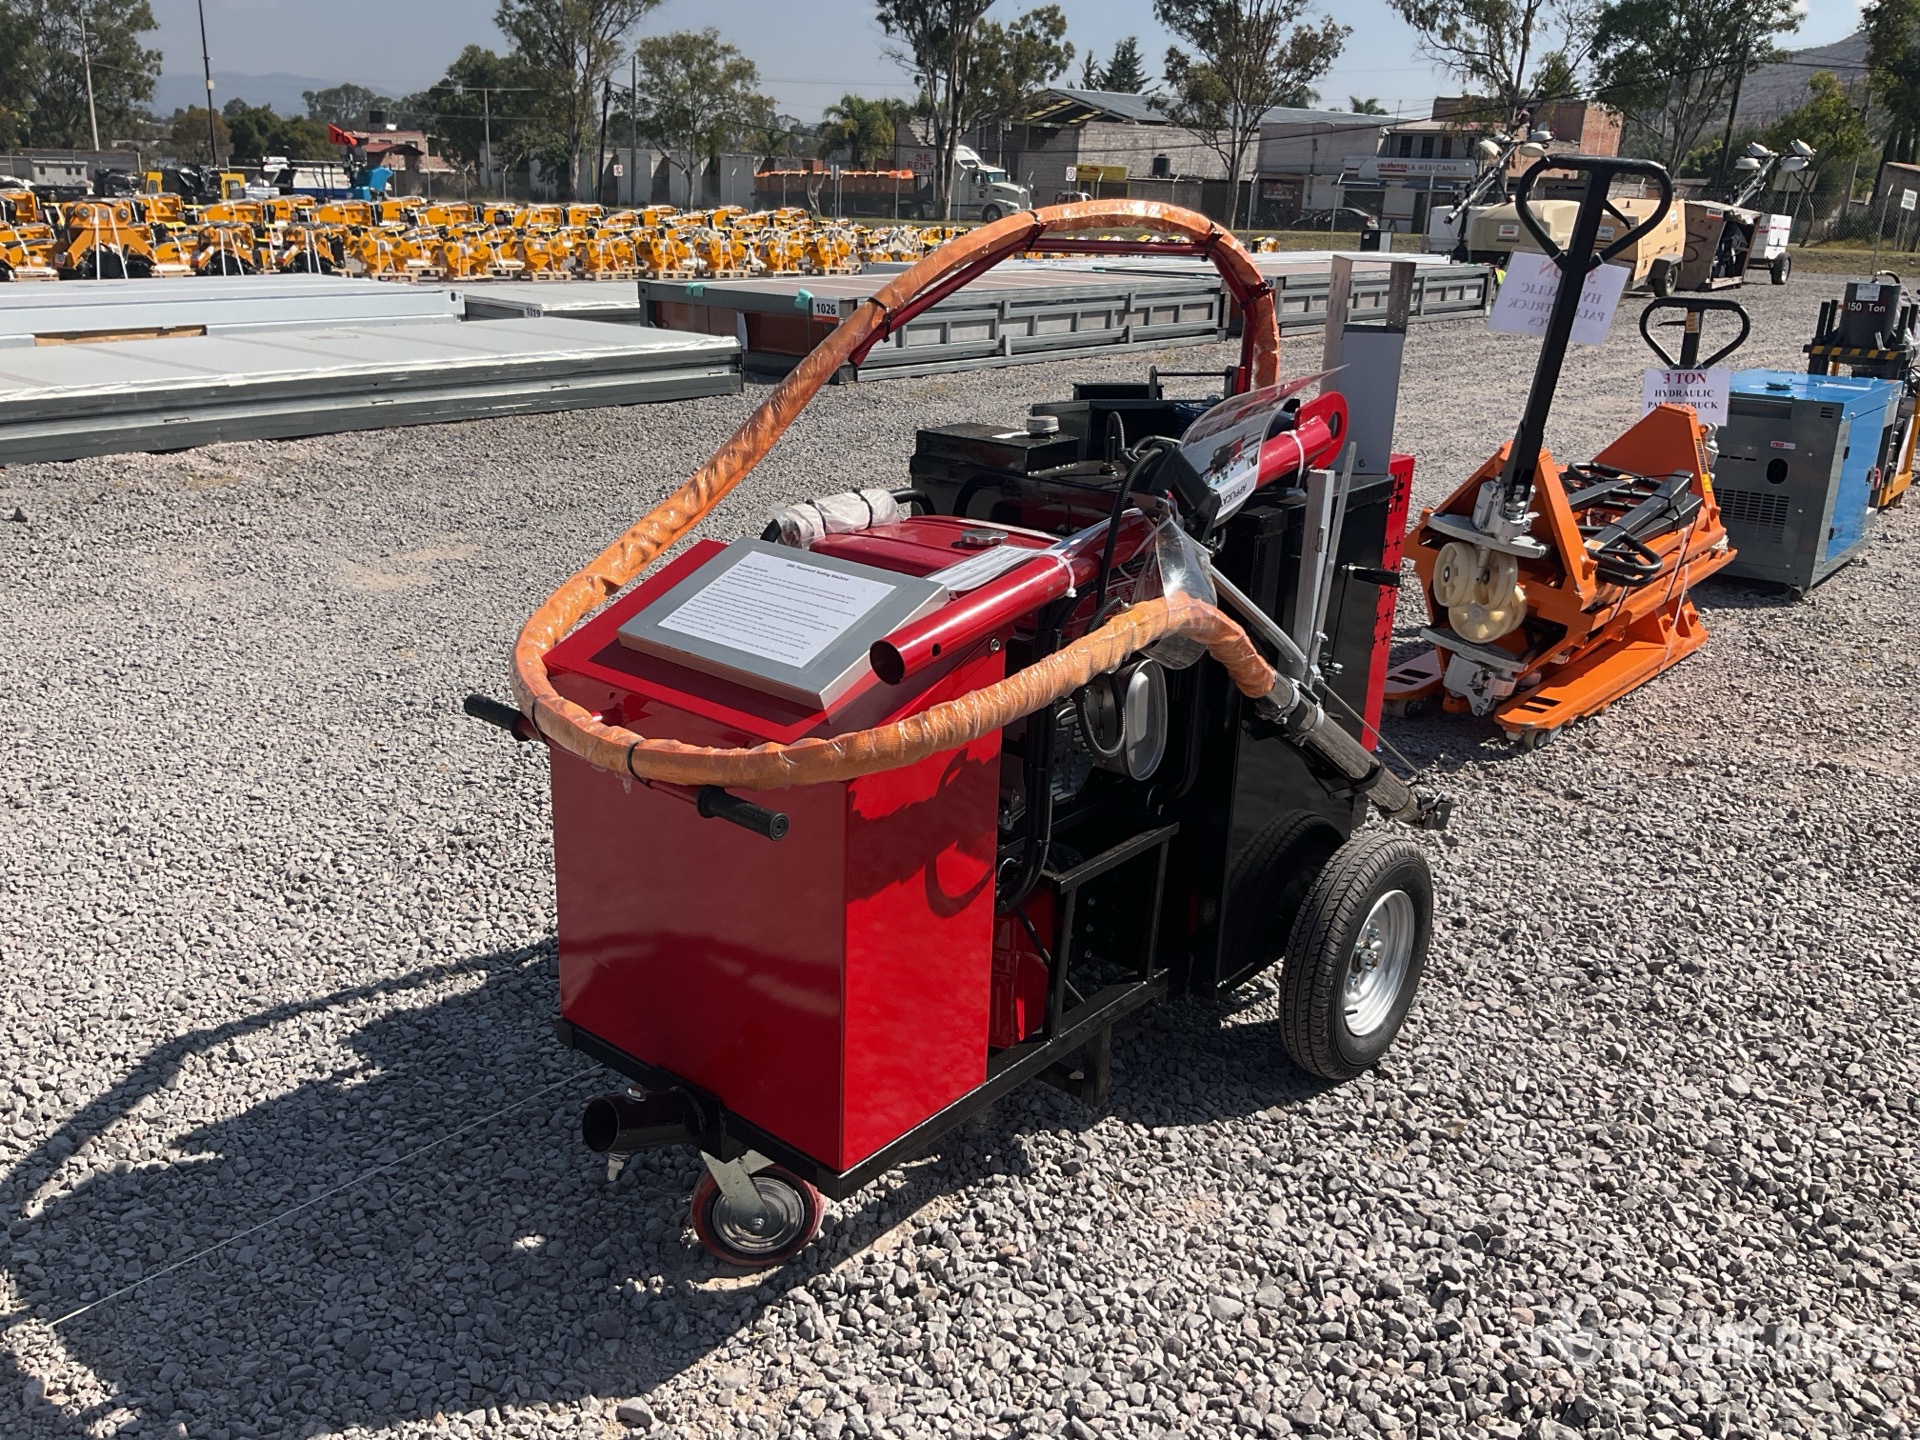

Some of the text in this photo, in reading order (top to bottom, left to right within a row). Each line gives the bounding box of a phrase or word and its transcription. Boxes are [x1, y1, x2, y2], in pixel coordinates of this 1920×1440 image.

[915, 153, 931, 161] SE
[907, 160, 933, 170] RENT
[1418, 164, 1457, 172] MEXICANA
[816, 302, 836, 315] 1026
[1847, 302, 1886, 312] 150 Ton
[1663, 372, 1707, 385] 3 TON
[1654, 389, 1715, 398] HYDRAULIC
